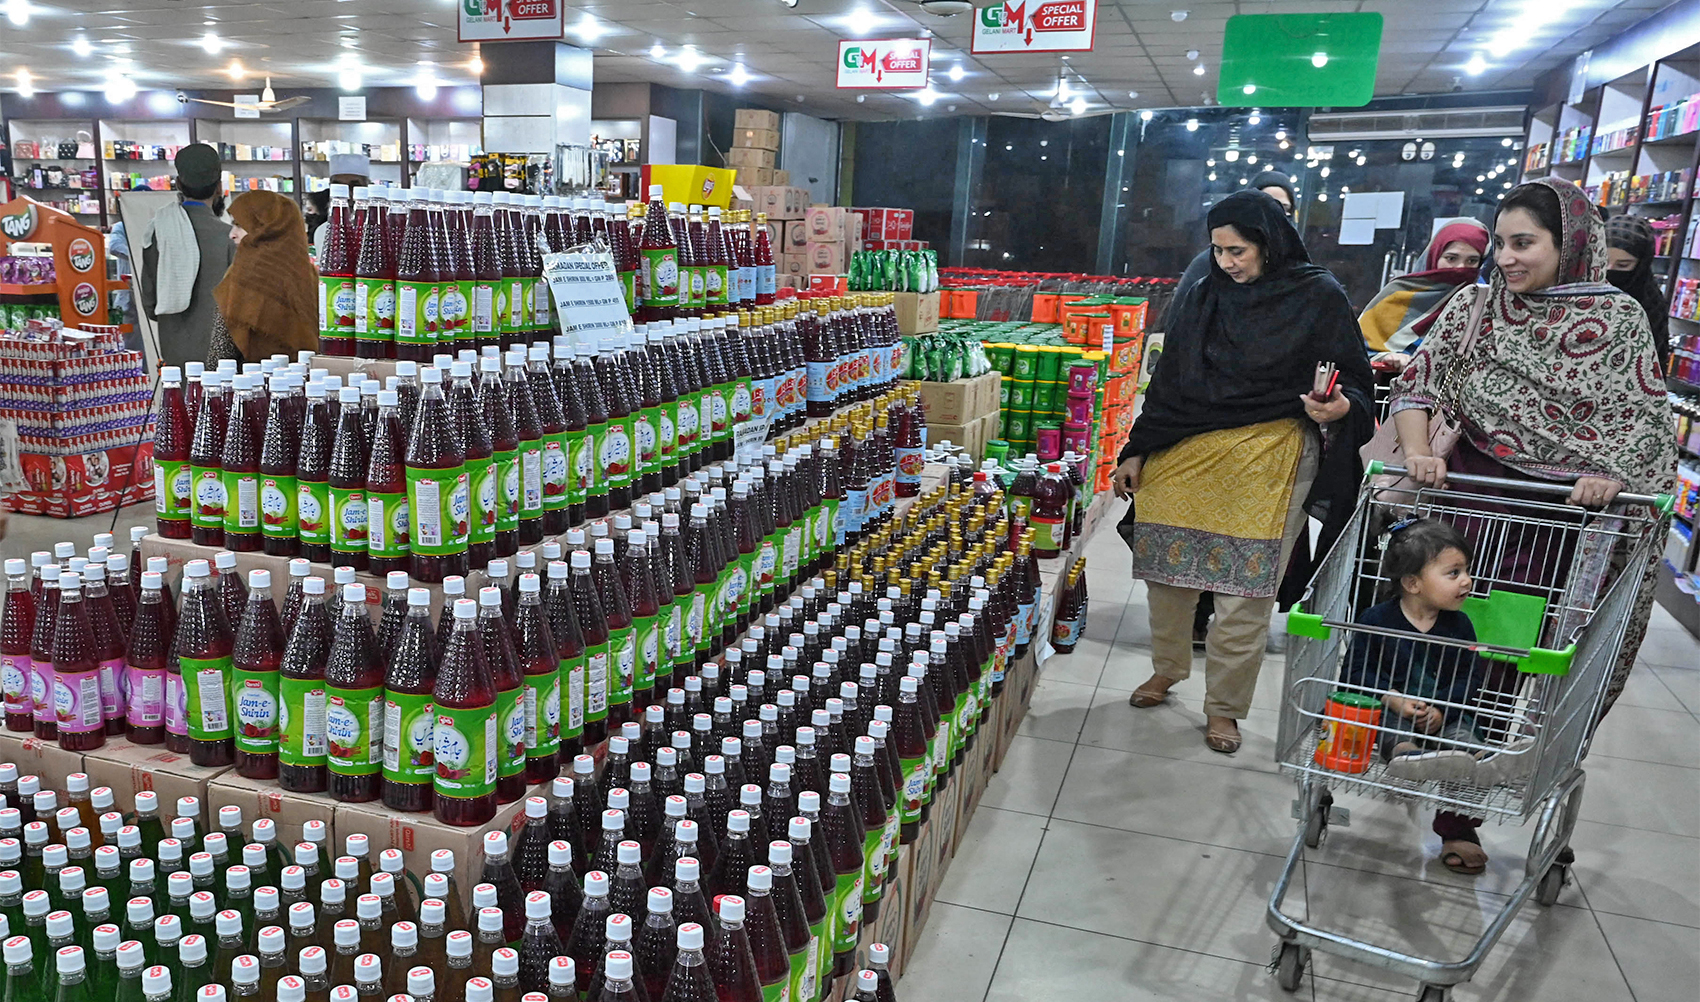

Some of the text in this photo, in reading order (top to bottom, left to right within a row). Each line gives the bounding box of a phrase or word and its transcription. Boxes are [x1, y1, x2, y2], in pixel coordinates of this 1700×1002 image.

[518, 4, 549, 16] OFFER
[1042, 4, 1083, 16] SPECIAL
[1042, 15, 1078, 27] OFFER
[889, 60, 917, 70] OFFER
[2, 212, 31, 236] TANG
[74, 254, 91, 268] TANG
[547, 261, 574, 271] MADAN
[574, 261, 591, 270] SPECIAL
[78, 297, 95, 312] TANG
[336, 295, 356, 304] Jam-e
[560, 300, 570, 308] JAM
[566, 324, 578, 333] JAM
[344, 508, 367, 517] Jam-e
[240, 696, 271, 708] Jam-e-
[240, 706, 270, 718] Shirin
[328, 712, 354, 727] am-e-
